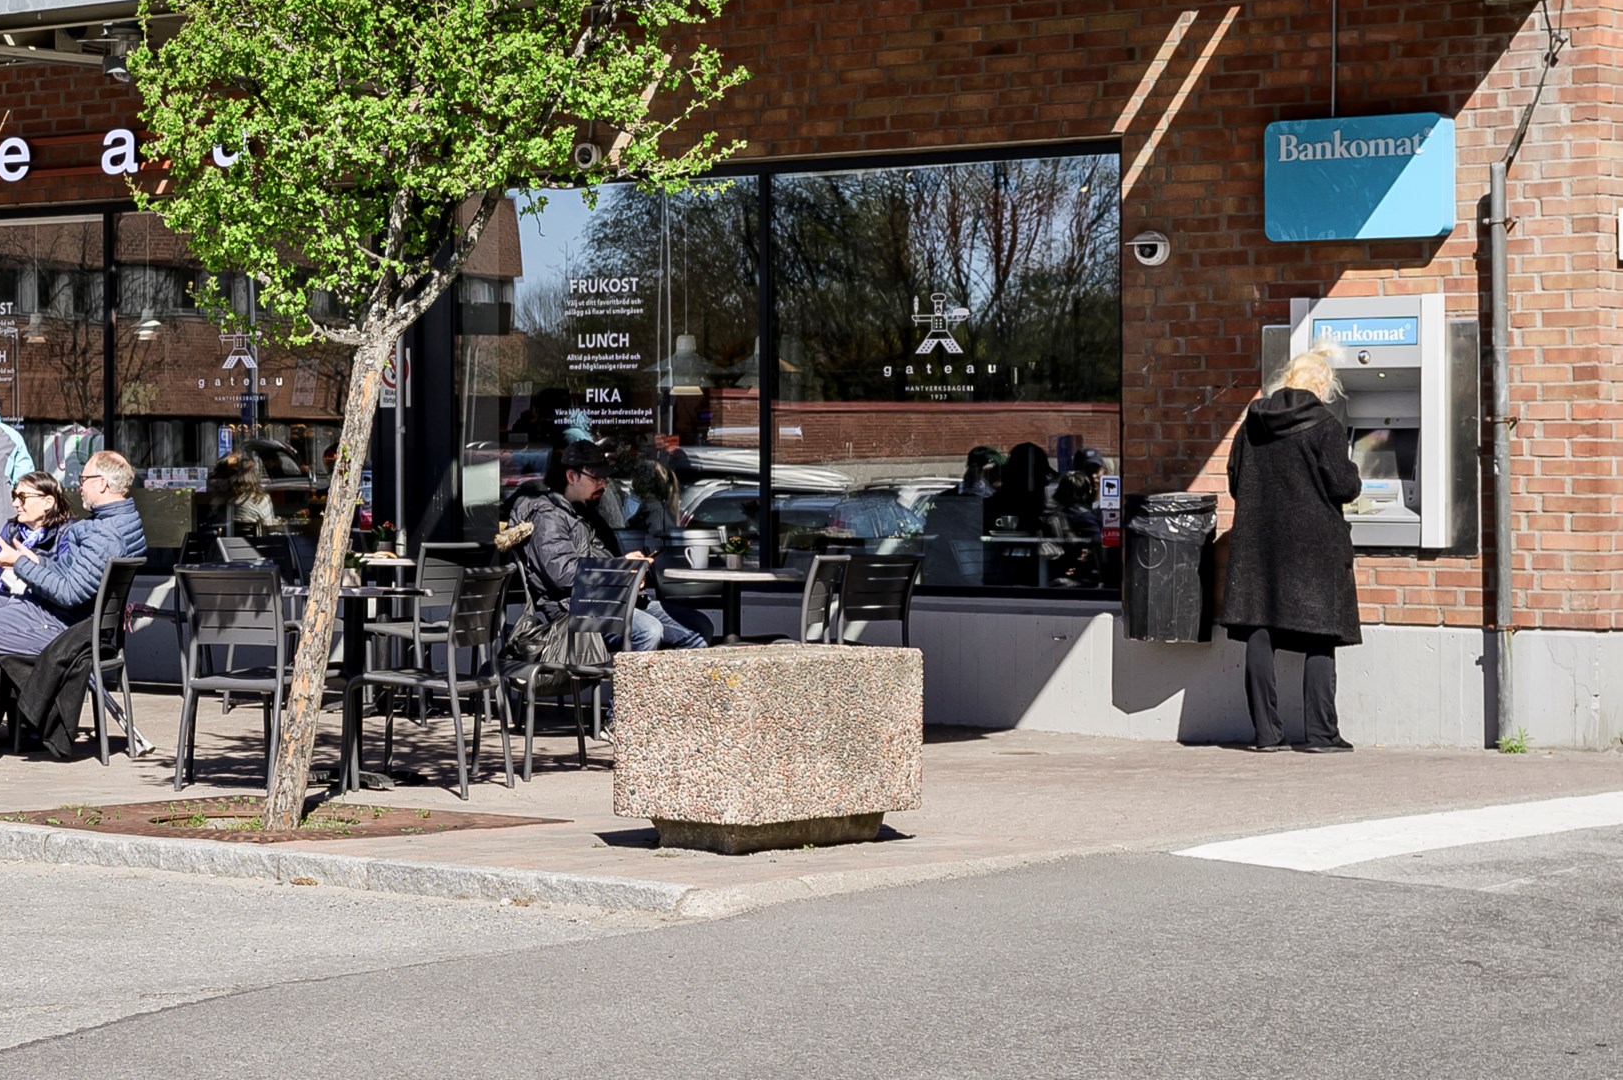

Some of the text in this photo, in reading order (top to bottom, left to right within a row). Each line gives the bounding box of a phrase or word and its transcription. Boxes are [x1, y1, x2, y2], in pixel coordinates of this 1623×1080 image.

[569, 277, 639, 294] FRUKOST
[567, 300, 578, 308] Välj
[578, 332, 630, 348] LUNCH
[1320, 324, 1406, 342] Bankomat
[883, 363, 996, 377] gateau
[198, 376, 283, 388] gateau
[585, 388, 622, 403] FIKA
